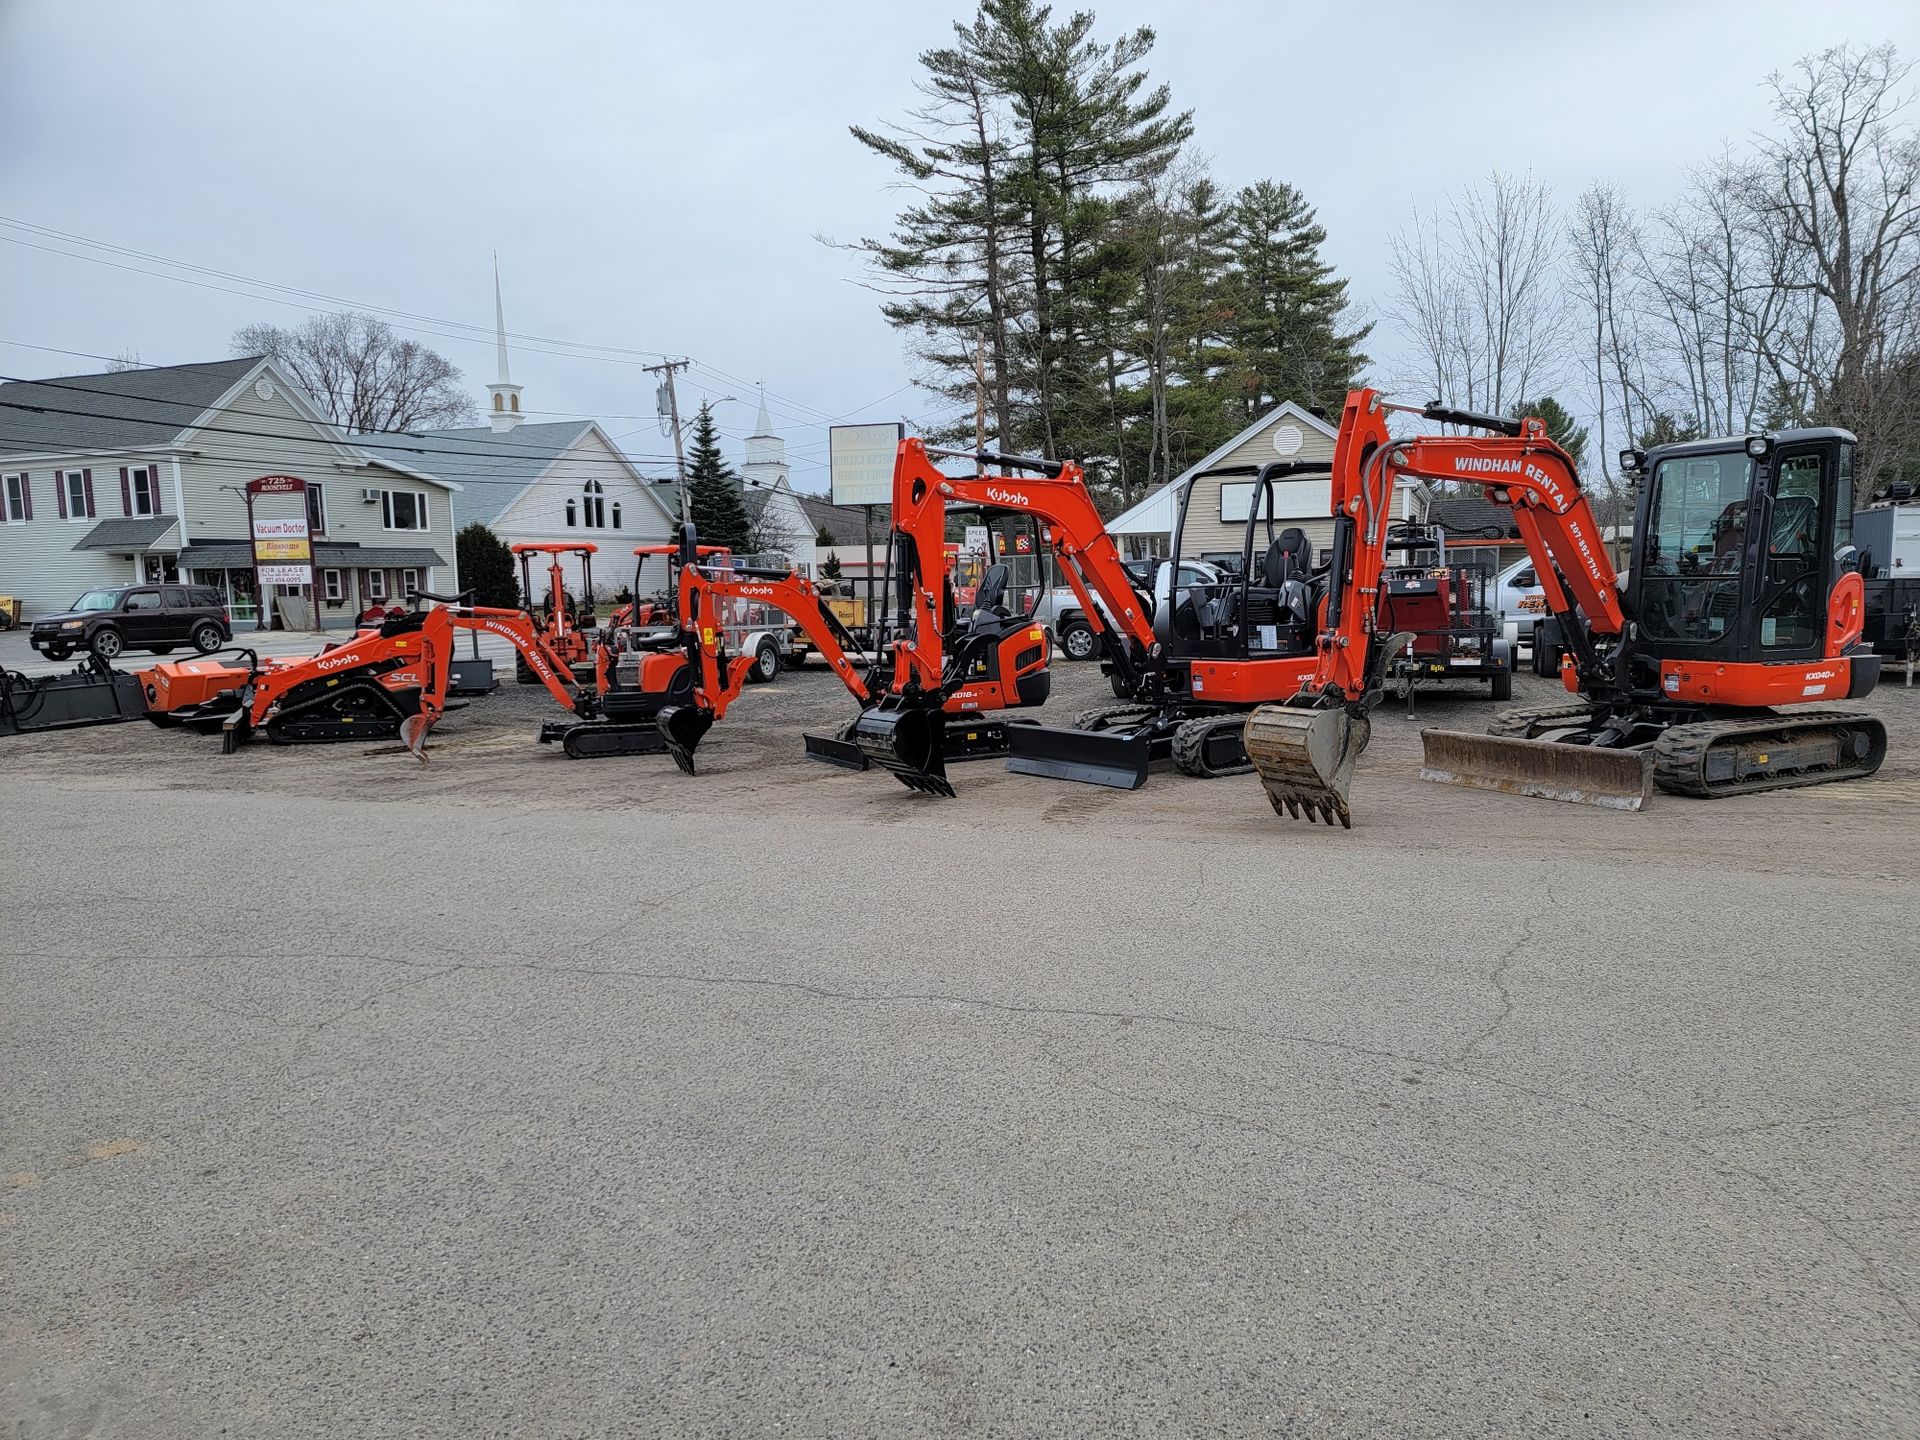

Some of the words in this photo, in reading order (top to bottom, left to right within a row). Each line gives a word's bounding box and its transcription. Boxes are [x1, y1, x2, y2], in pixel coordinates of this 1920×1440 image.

[267, 477, 286, 485] 725
[1455, 457, 1522, 473] WINDHAM
[1525, 463, 1569, 514] RENTAL
[986, 487, 1029, 506] Kubota
[255, 523, 281, 533] Vacuum
[283, 523, 305, 533] Doctor
[266, 542, 300, 550] Blossoms
[740, 586, 774, 595] Kubota
[485, 620, 529, 648] WINDHAM
[528, 650, 552, 680] RENTAL
[317, 654, 360, 670] Kubota
[390, 673, 420, 682] SCL
[1805, 670, 1835, 680] KX040-4
[949, 691, 978, 699] X018-4
